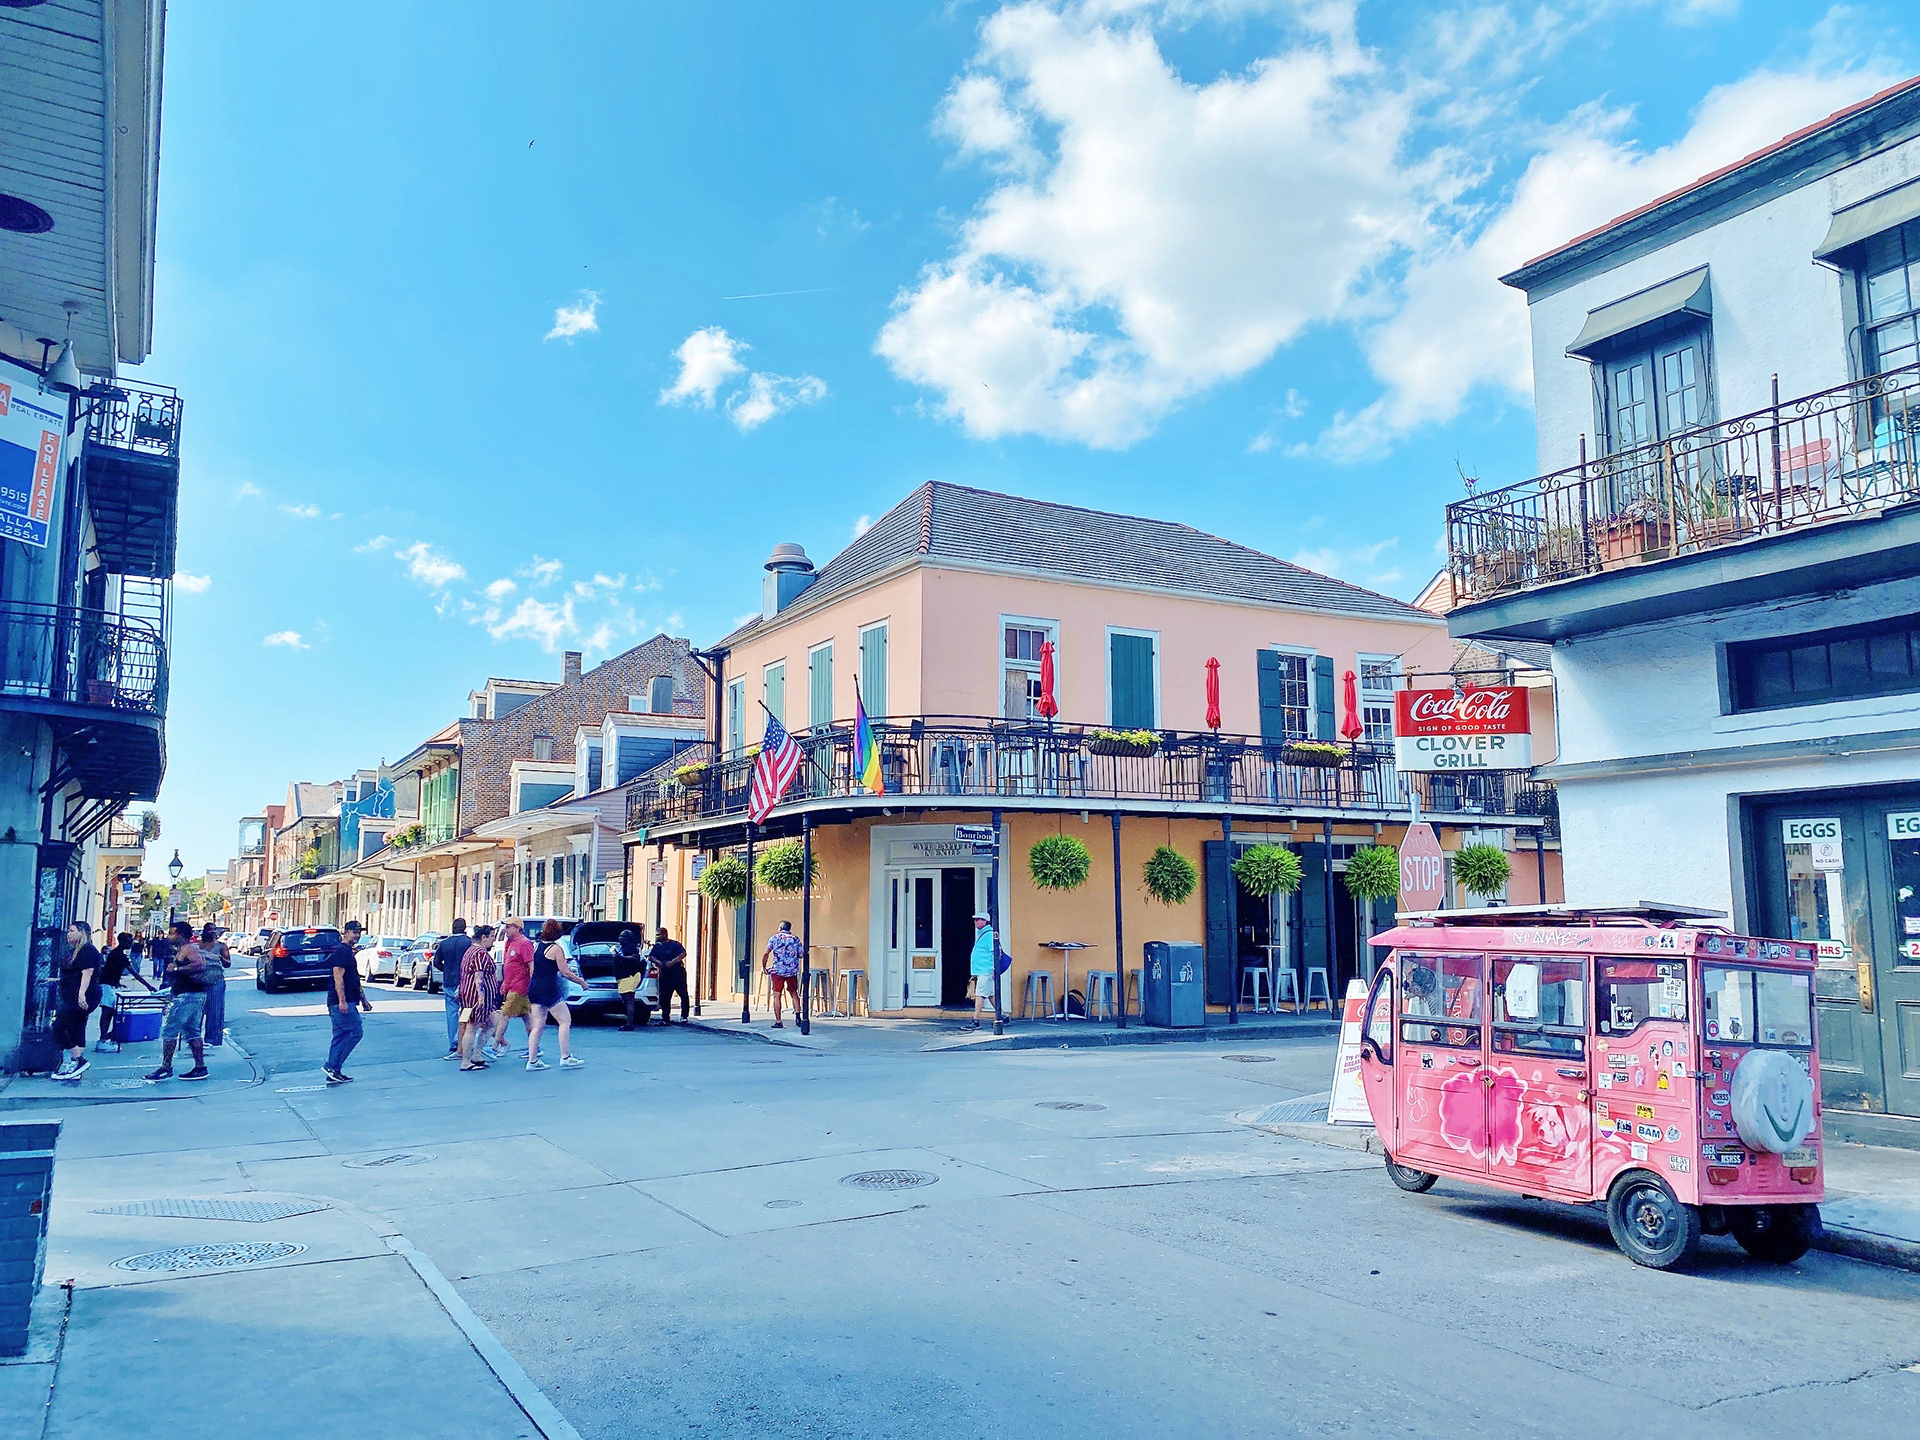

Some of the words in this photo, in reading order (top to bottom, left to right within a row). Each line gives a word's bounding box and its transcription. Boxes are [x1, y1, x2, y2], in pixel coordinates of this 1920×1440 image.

[10, 403, 31, 416] REAL
[33, 412, 63, 428] ESTATE
[42, 433, 55, 465] FOR
[0, 486, 28, 503] 9515
[35, 467, 50, 520] LEASE
[1441, 724, 1452, 732] OF
[1416, 735, 1505, 751] CLOVER
[1433, 753, 1487, 768] GRILL
[957, 830, 992, 840] Bourbon
[1790, 822, 1836, 839] EGGS
[1404, 856, 1440, 892] STOP
[1820, 945, 1841, 955] HRS
[1638, 1125, 1660, 1139] BAM
